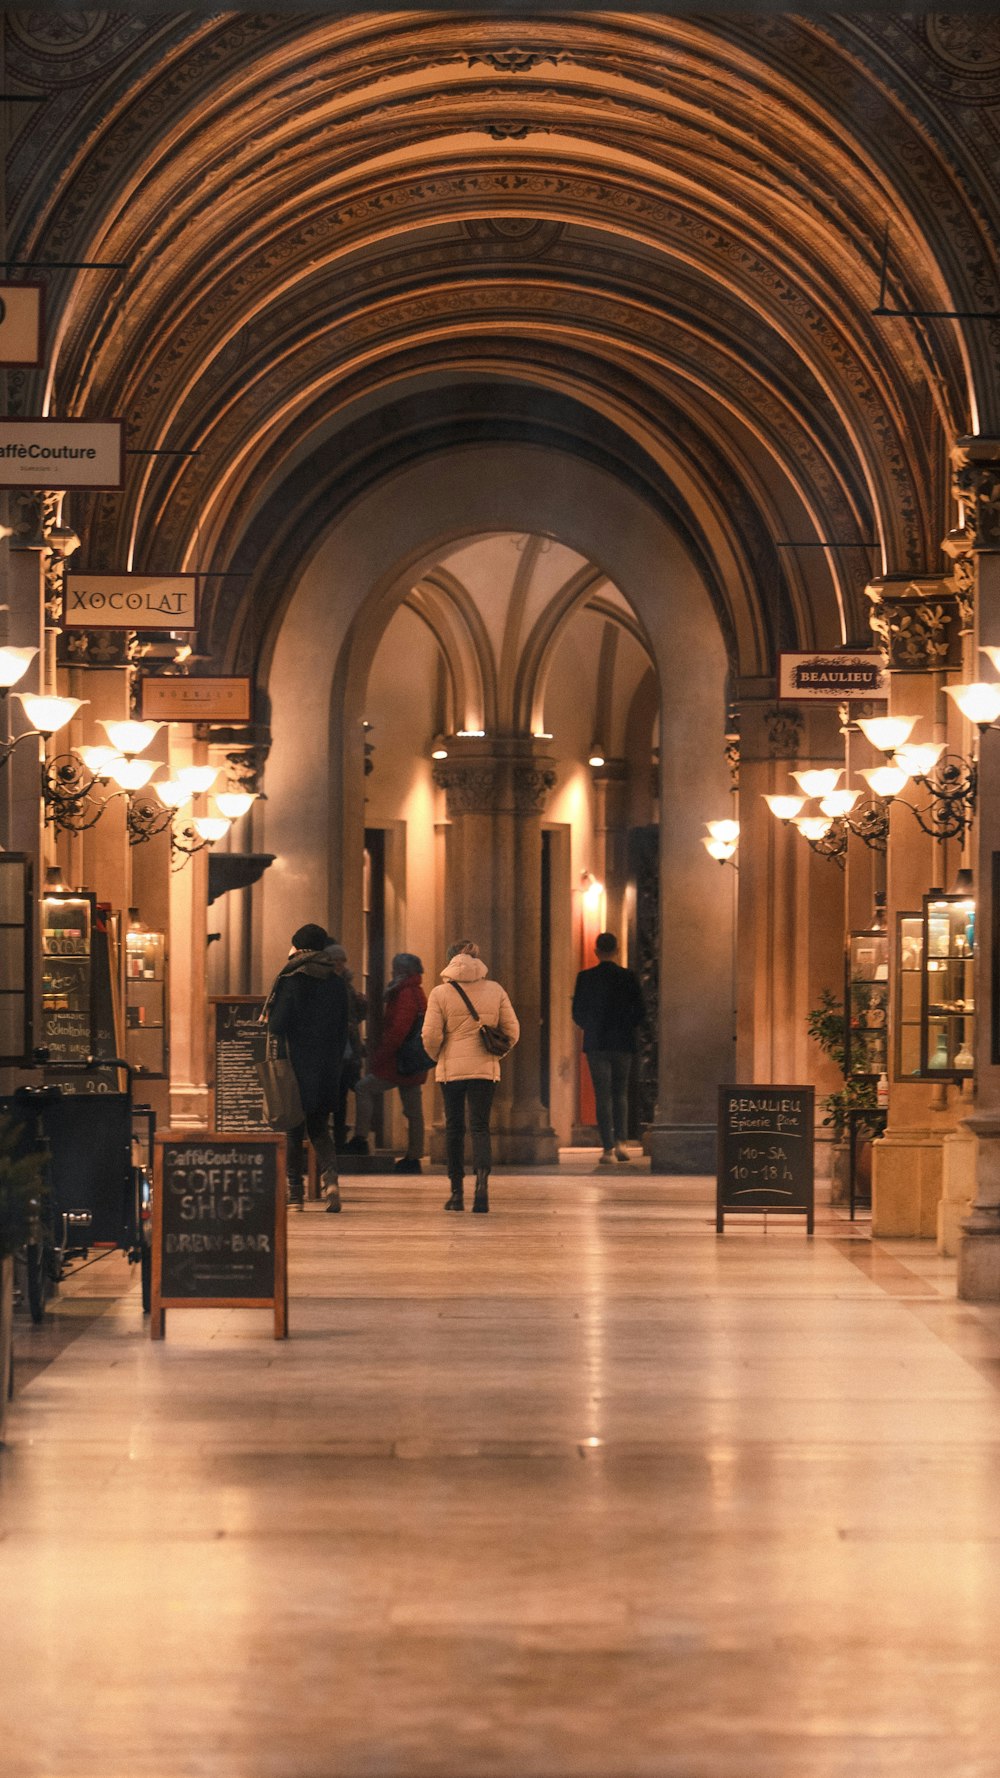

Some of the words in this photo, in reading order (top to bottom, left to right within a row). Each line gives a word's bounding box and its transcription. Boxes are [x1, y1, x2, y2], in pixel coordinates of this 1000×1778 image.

[71, 590, 191, 615] XOCOLAT
[800, 672, 873, 682] BEAULIEU
[728, 1098, 802, 1113] BEAULIEU
[171, 1169, 265, 1194] COFFEE
[180, 1195, 255, 1220] SHOP
